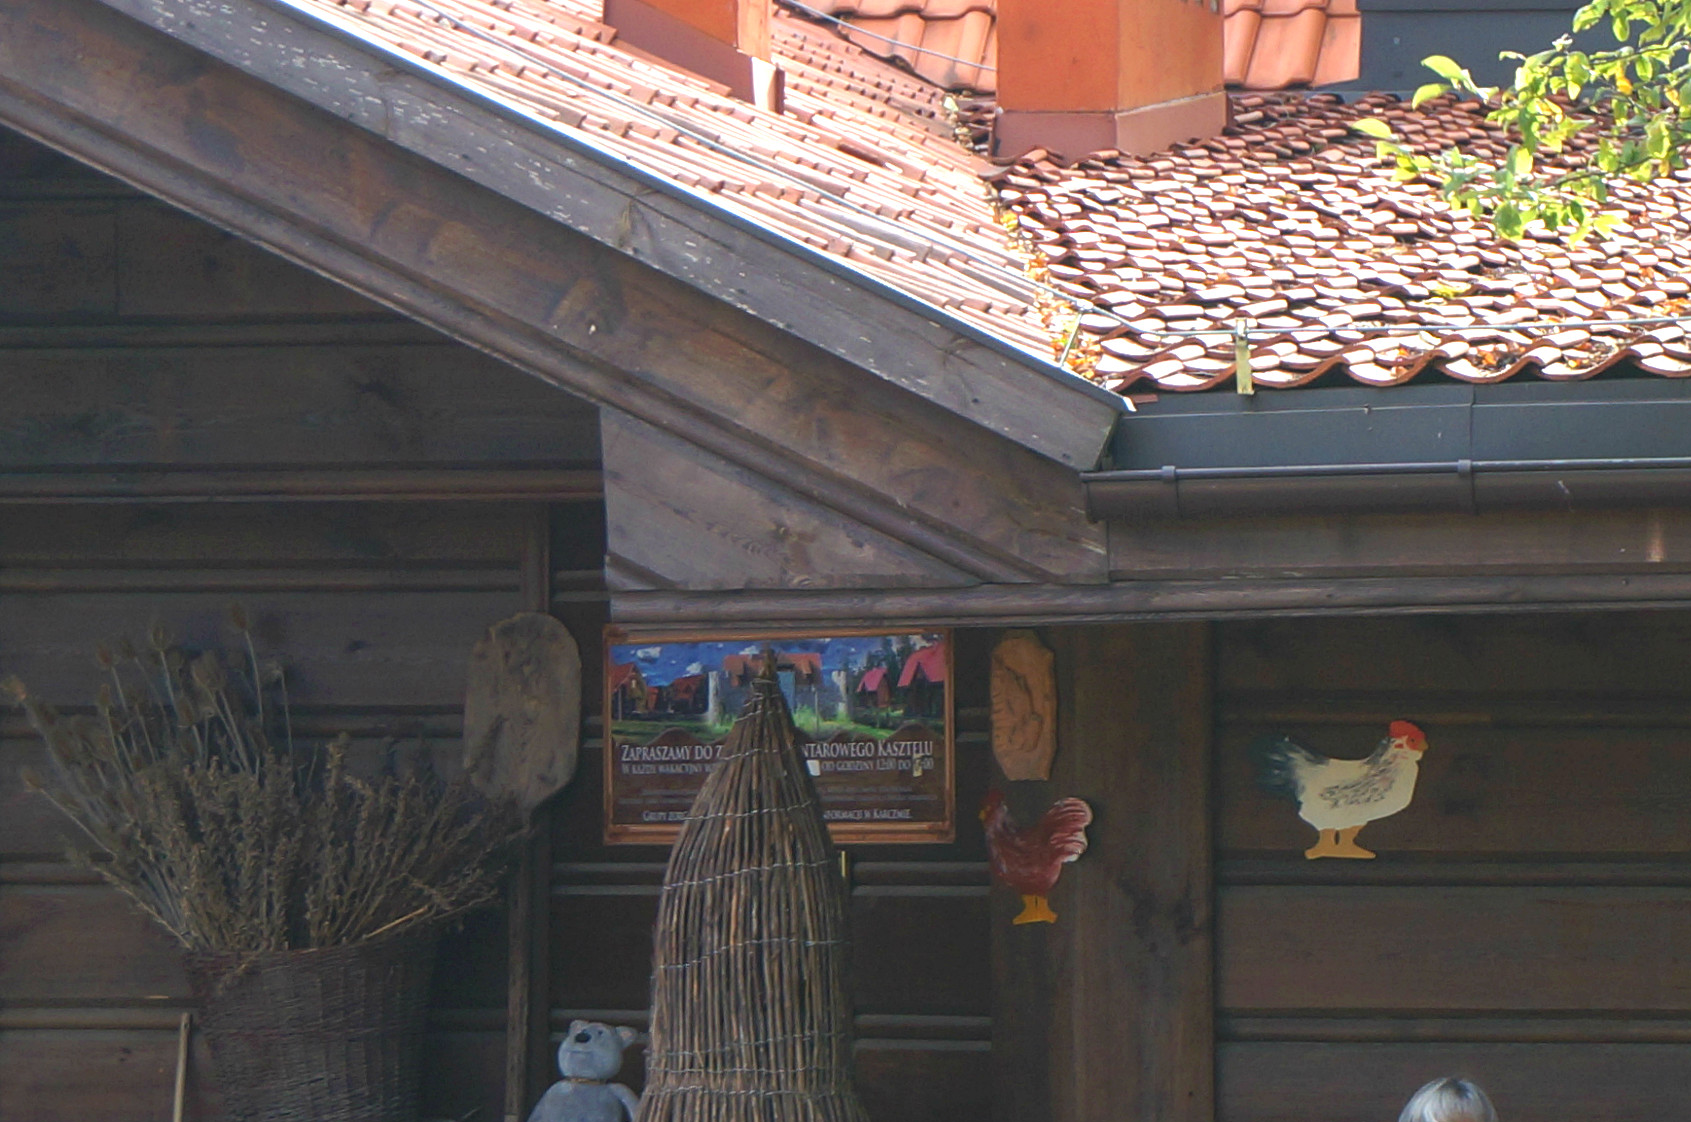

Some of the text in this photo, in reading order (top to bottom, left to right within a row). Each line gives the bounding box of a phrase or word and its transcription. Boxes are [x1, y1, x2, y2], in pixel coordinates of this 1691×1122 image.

[621, 744, 691, 761] ZAPRASZAMY
[694, 744, 713, 760] DO
[801, 742, 875, 758] NTAROWEGO
[877, 741, 933, 757] KASZTELU
[836, 760, 874, 771] GODZINY
[898, 759, 911, 770] DO
